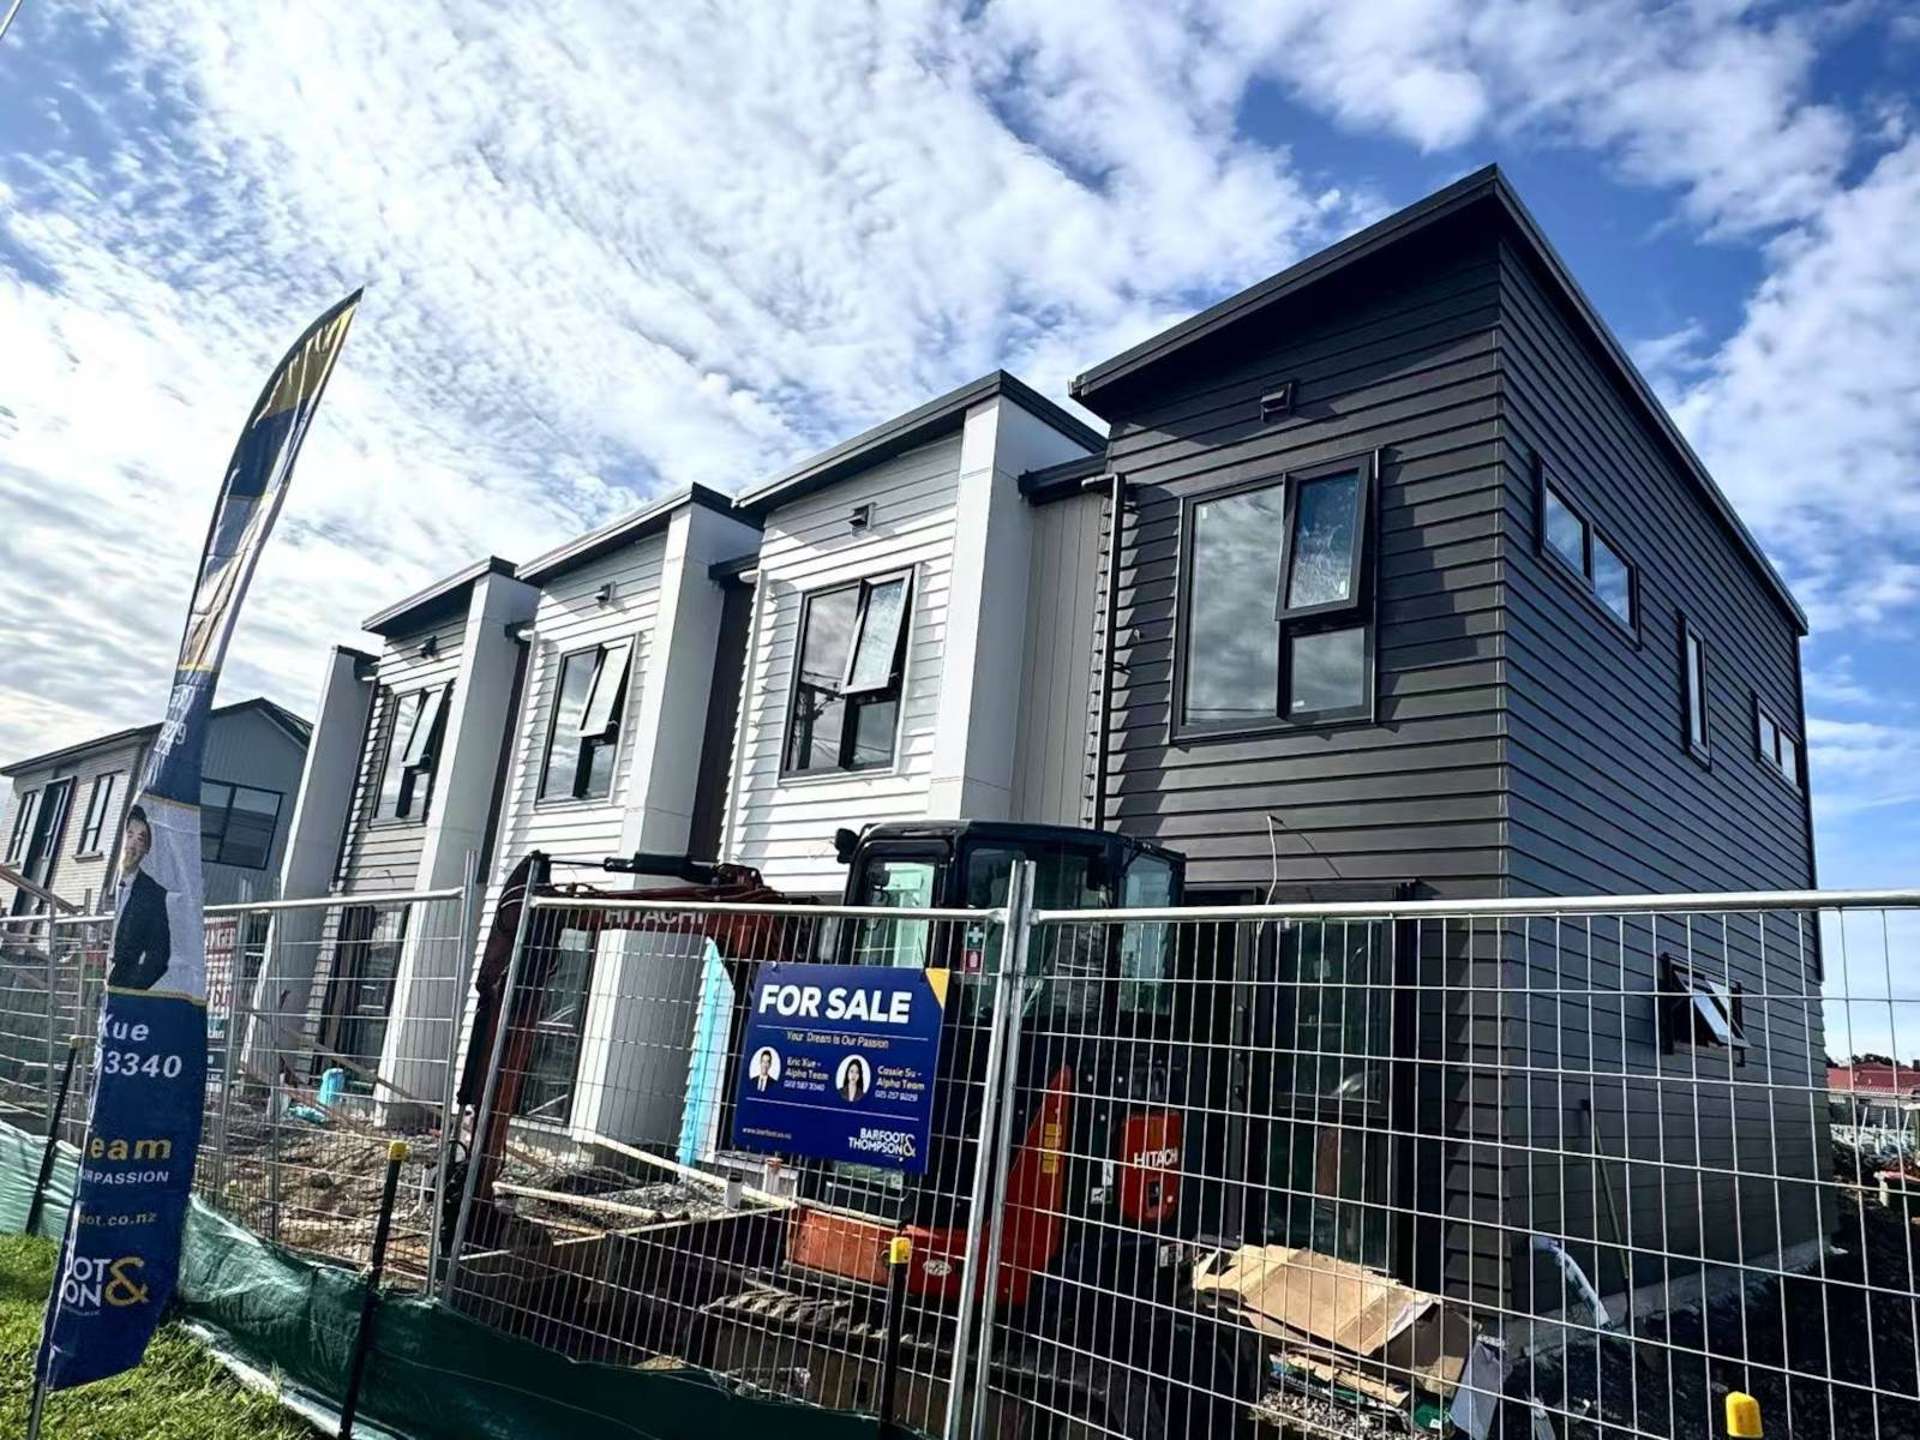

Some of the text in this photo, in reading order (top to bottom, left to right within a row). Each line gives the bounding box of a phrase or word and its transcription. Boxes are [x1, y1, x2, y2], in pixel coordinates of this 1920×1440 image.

[604, 908, 703, 924] HITACHI
[758, 984, 912, 1024] FOR SALE
[787, 1030, 804, 1042] Your
[807, 1031, 831, 1044] Dream
[841, 1035, 856, 1046] Our
[857, 1037, 889, 1049] Passion
[104, 1050, 182, 1078] 3340
[785, 1067, 829, 1080] Alpha Team
[876, 1077, 925, 1090] Alpha Team
[860, 1128, 905, 1143] BARFOOT
[91, 1138, 172, 1160] eam
[848, 1136, 903, 1155] THOMPSON
[1133, 1147, 1178, 1169] HITACH
[94, 1170, 169, 1184] PASSION
[73, 1256, 112, 1282] OT
[65, 1279, 102, 1307] ON
